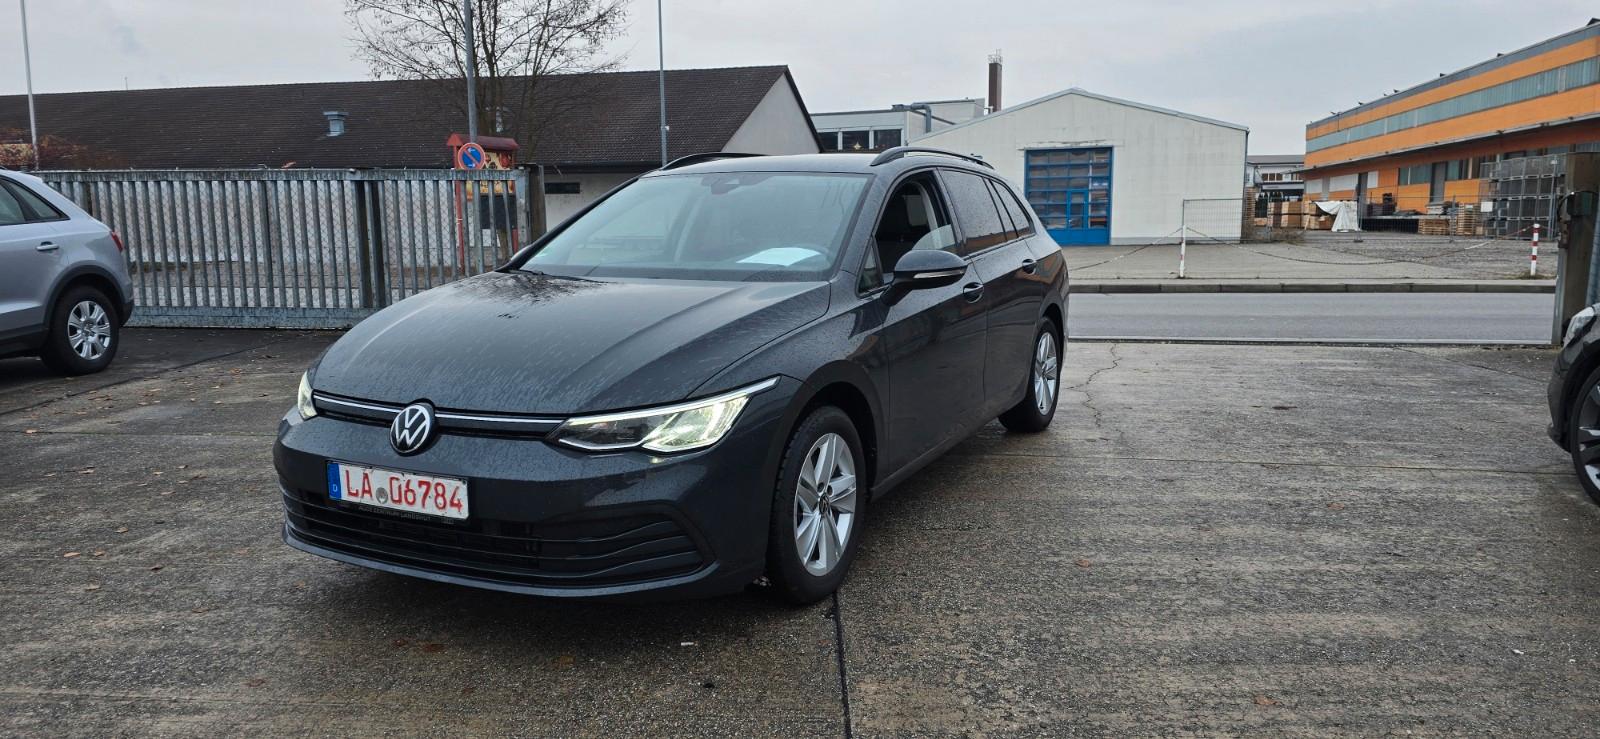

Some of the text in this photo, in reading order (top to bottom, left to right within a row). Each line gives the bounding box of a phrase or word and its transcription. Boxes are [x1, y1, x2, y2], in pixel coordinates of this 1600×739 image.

[391, 405, 430, 453] VW
[332, 484, 338, 493] D
[345, 470, 463, 512] LA 06784
